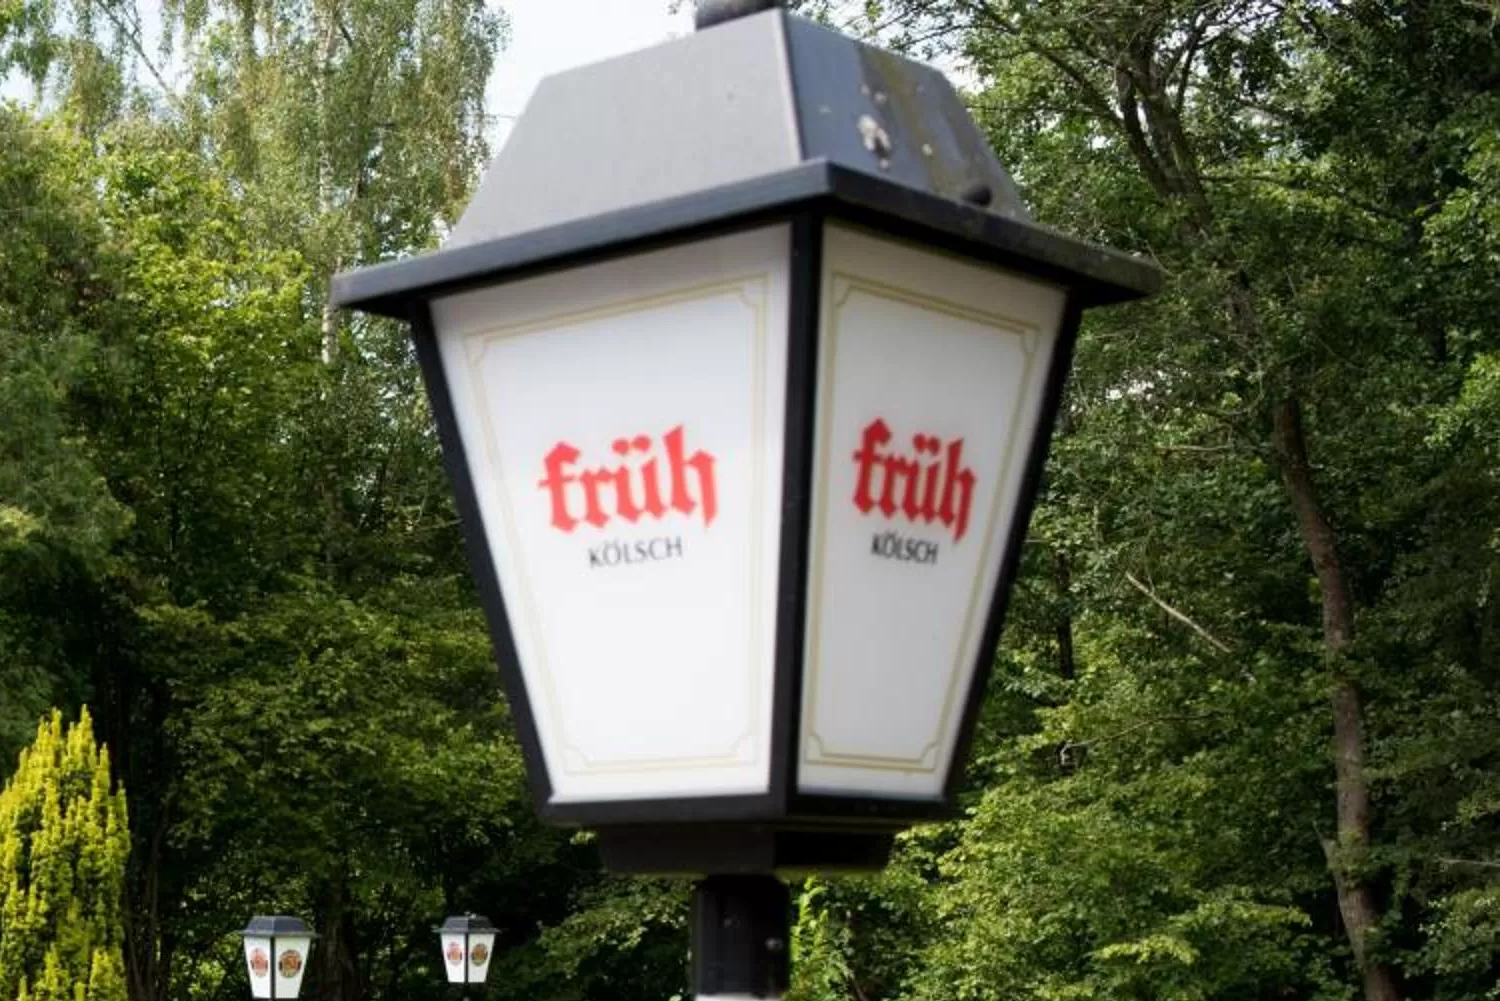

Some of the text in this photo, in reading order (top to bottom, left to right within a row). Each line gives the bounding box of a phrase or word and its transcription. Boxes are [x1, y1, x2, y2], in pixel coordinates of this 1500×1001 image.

[538, 425, 718, 532] früh
[853, 417, 977, 543] früh
[588, 536, 684, 567] KÖLSCH
[871, 533, 939, 564] KÖLSCH
